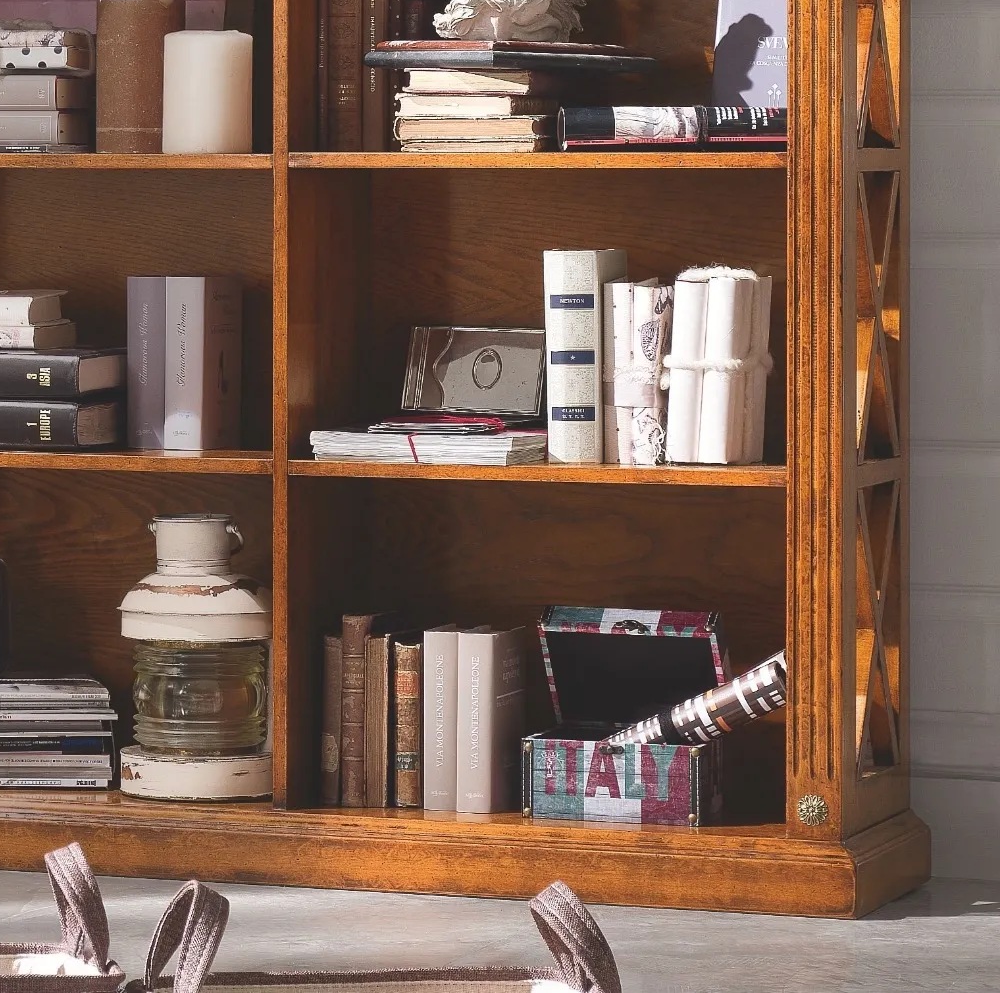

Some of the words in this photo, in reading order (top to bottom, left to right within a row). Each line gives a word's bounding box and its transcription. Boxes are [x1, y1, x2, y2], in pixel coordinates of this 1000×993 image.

[137, 302, 148, 336] Woman
[175, 303, 187, 337] Woman
[39, 368, 51, 387] ASIA
[137, 340, 148, 386] Glamorous
[175, 340, 187, 387] Glamorous
[39, 409, 51, 440] EUROPE
[435, 654, 444, 748] MONTENAPOLEONE
[470, 656, 480, 750] MONTENAPOLEONE
[436, 750, 444, 767] VIA
[470, 751, 479, 770] VIA
[544, 739, 683, 801] ITALY
